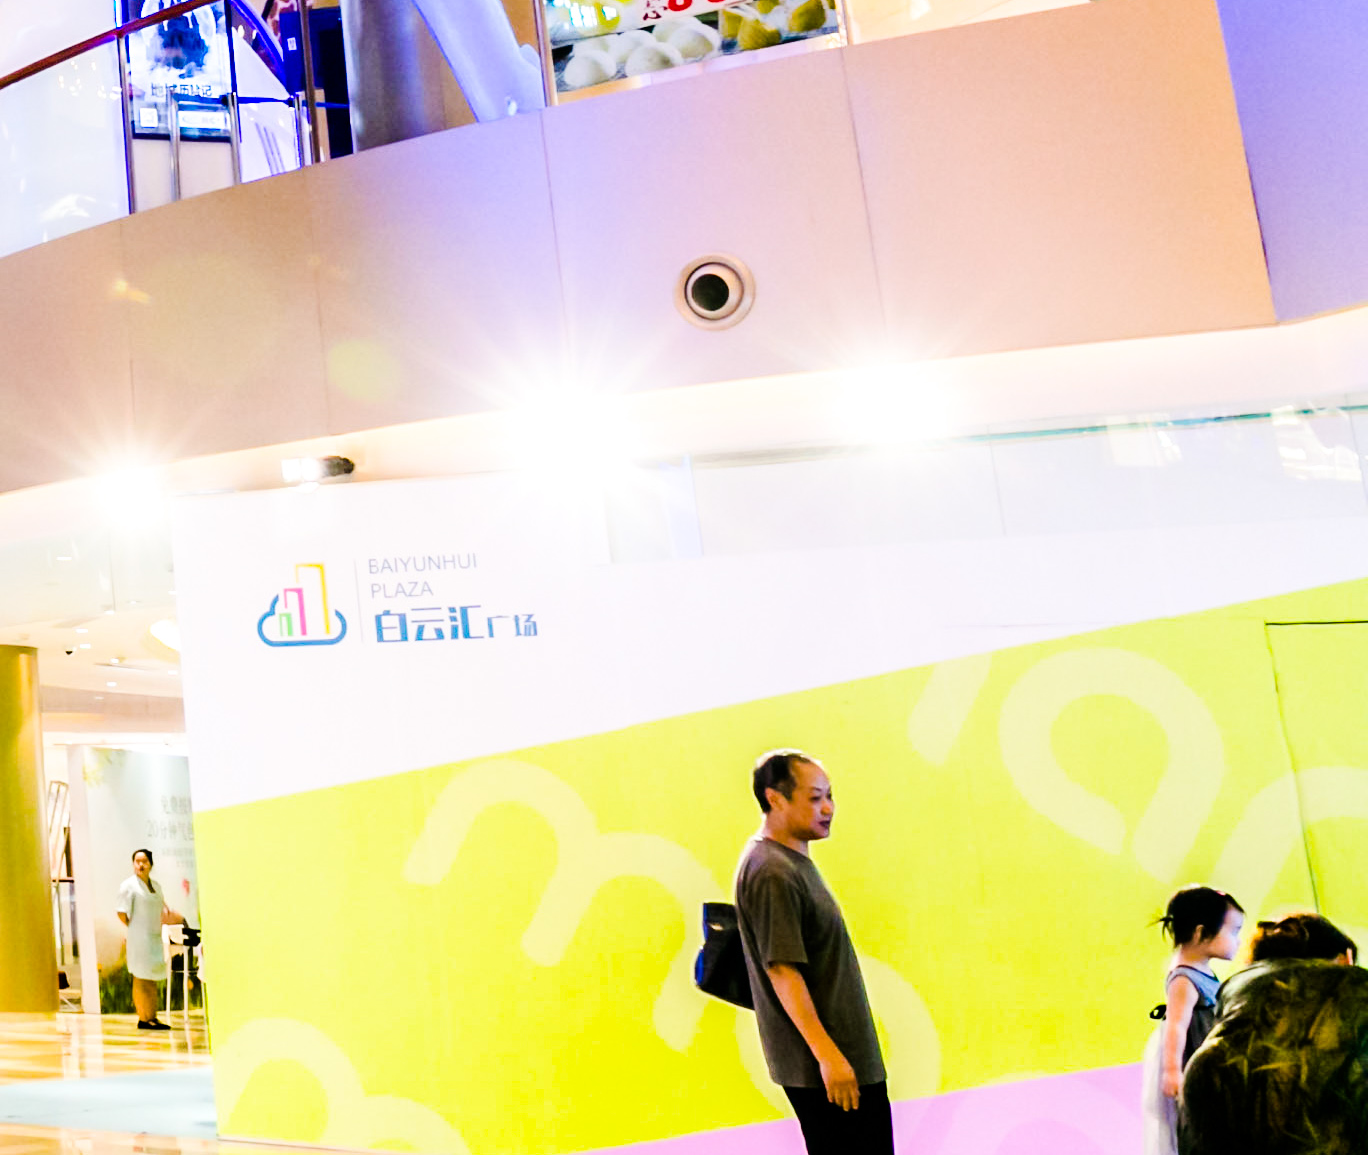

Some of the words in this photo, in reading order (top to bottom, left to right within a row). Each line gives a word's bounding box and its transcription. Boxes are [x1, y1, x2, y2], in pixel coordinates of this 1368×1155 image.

[368, 552, 477, 575] BAIYUNHUI
[370, 580, 434, 599] PLAZA
[374, 604, 538, 643] 白云汇广场
